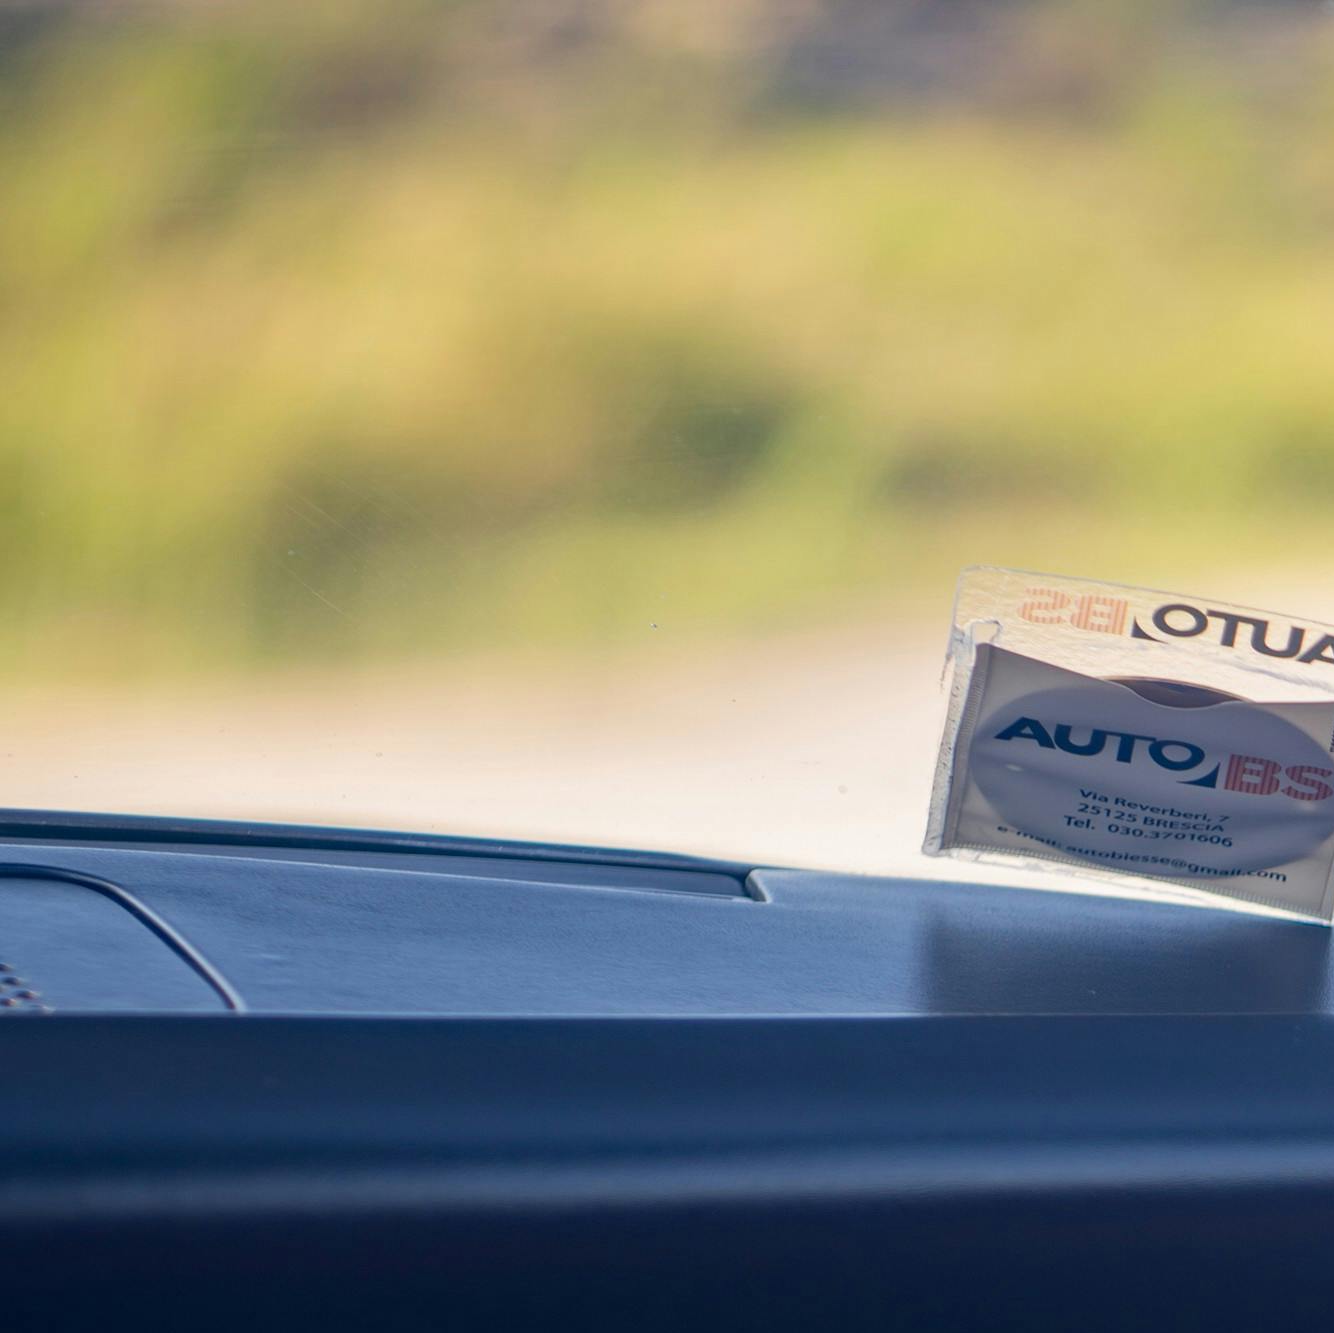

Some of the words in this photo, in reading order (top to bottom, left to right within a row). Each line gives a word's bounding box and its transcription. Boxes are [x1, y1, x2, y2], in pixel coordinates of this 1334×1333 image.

[994, 716, 1205, 772] AUTO
[1223, 753, 1334, 801] BS
[1077, 802, 1137, 823] 25125
[1143, 815, 1225, 832] BRESCIA
[1079, 788, 1108, 803] Via
[1114, 797, 1212, 823] Reverberi,
[1217, 814, 1230, 822] 7
[1063, 814, 1096, 830] Tel.
[1107, 823, 1233, 848] 030.3701606
[1065, 845, 1288, 882] autobiesse@gmail.com
